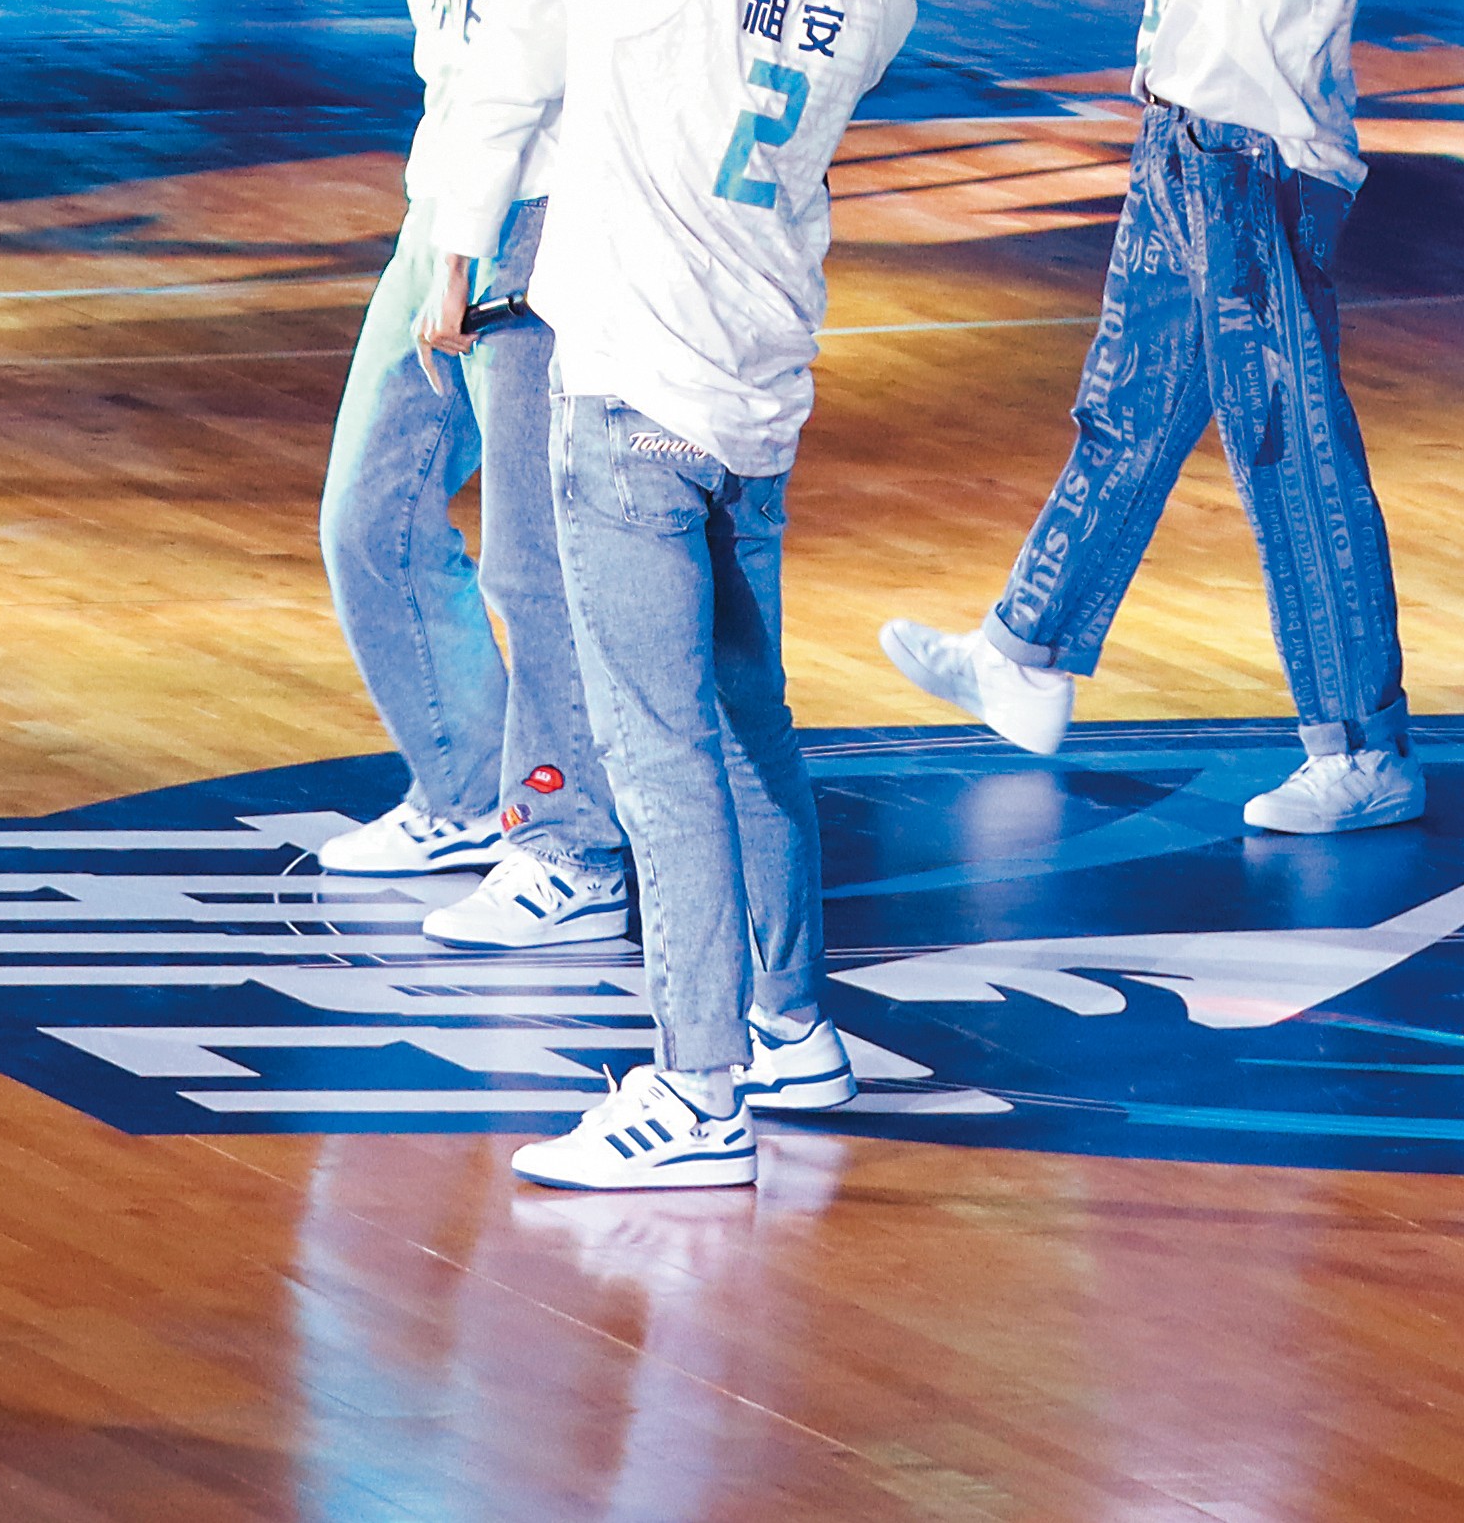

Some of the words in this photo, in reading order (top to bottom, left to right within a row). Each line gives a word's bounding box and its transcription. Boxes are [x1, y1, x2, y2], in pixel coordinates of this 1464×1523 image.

[711, 57, 811, 210] 2
[1012, 525, 1069, 622] This
[1056, 470, 1090, 519] is
